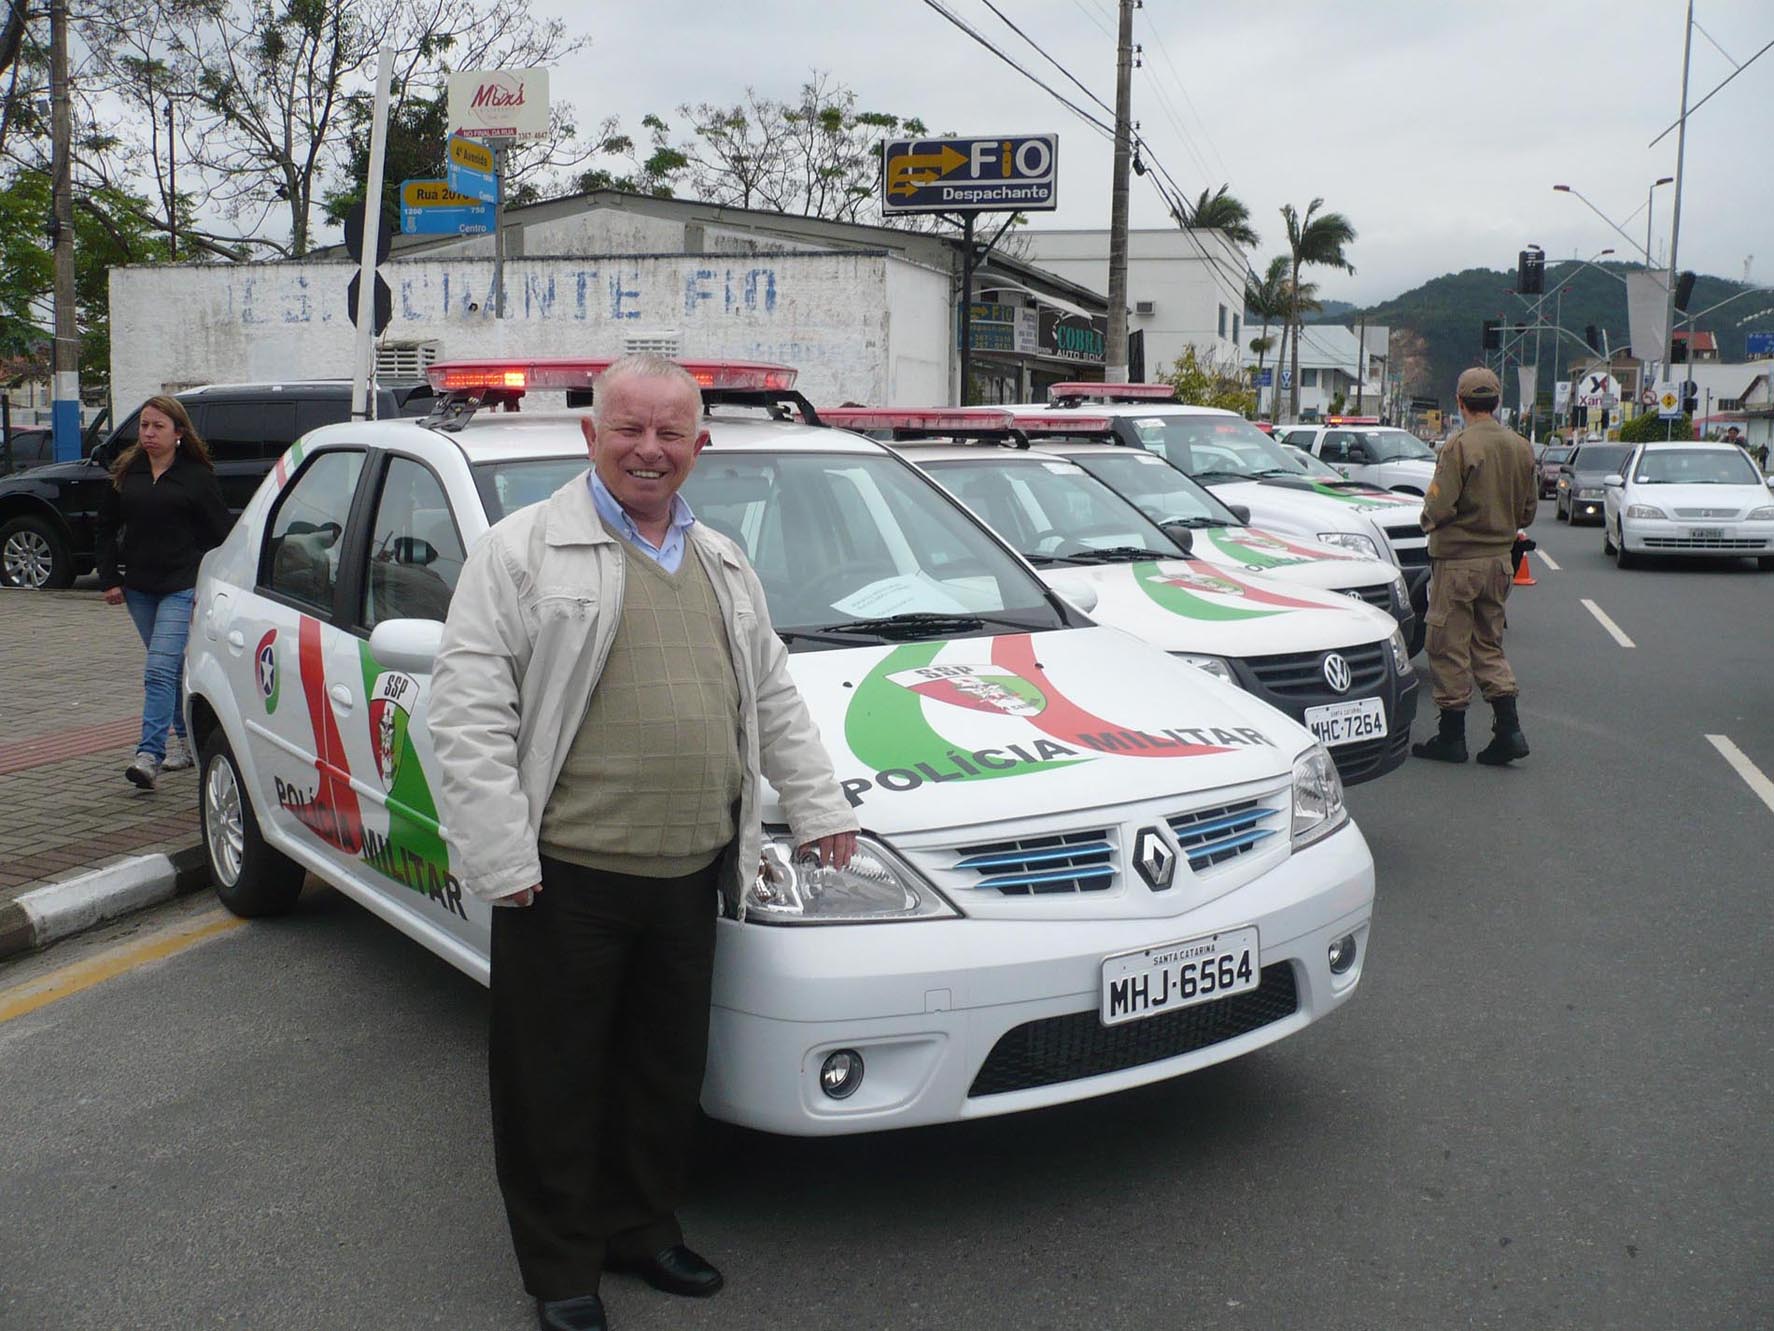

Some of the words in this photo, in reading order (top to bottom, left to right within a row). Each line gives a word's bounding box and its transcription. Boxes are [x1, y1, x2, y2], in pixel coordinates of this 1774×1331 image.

[416, 188, 438, 200] Rua
[943, 186, 1049, 202] Despachante
[459, 224, 487, 233] Centro
[1056, 349, 1080, 360] AUTO
[384, 674, 409, 700] SSP
[840, 738, 1080, 809] POLÍCIA
[1076, 727, 1278, 752] MILITAR
[361, 824, 469, 921] MILITAR
[1153, 955, 1178, 966] SANTA
[1179, 944, 1215, 959] CATARINA
